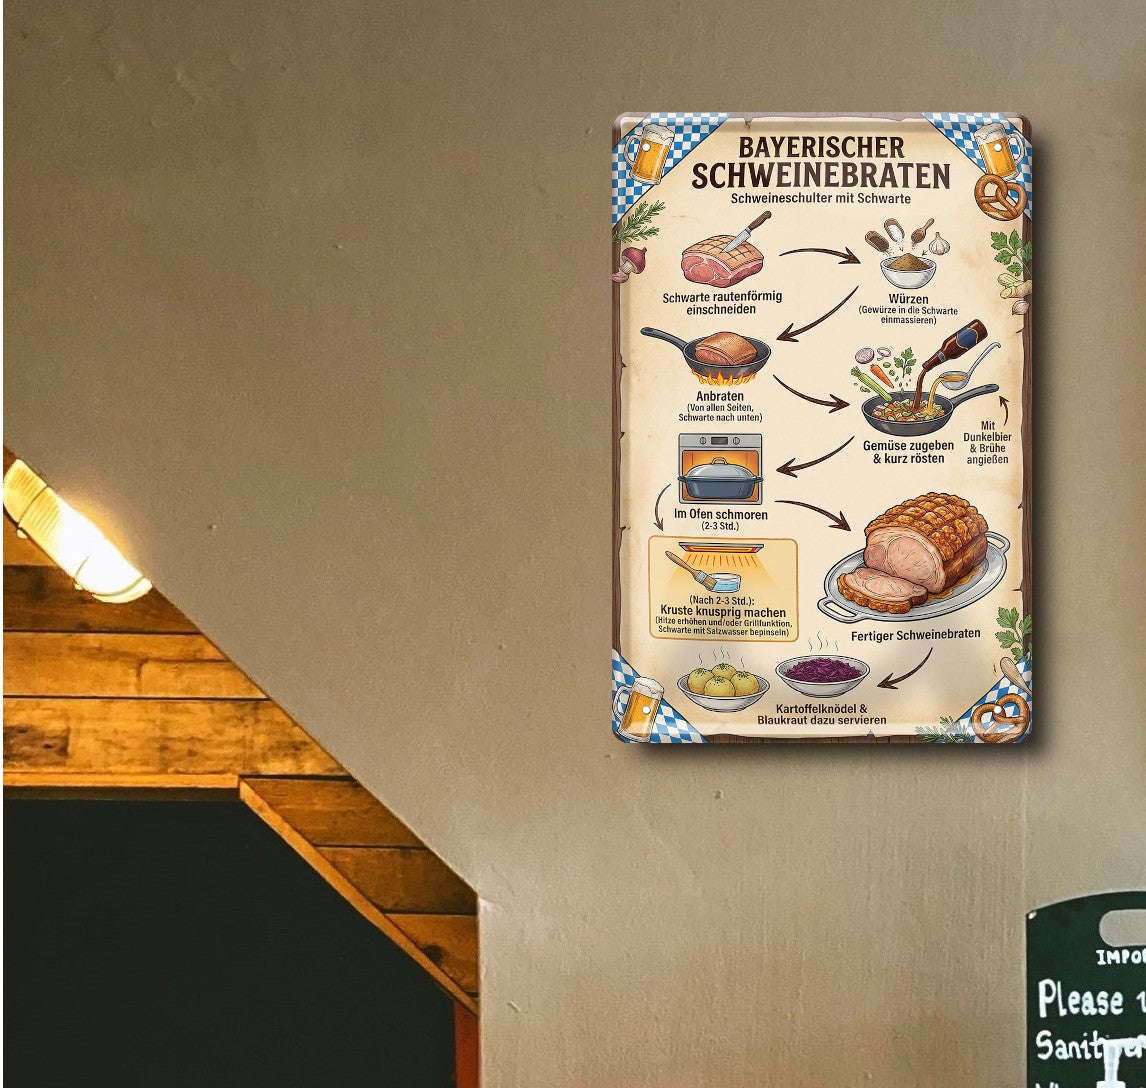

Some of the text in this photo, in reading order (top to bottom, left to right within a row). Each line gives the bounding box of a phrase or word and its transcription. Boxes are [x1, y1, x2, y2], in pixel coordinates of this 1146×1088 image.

[739, 136, 905, 158] BAYERISCHER
[691, 163, 951, 189] SCHWEINEBRATEN
[731, 192, 911, 204] Schweineschulter mit Schwarte
[663, 290, 782, 304] Schwarte rautenförmig
[889, 293, 929, 305] Würzen
[686, 303, 756, 316] einschneiden
[859, 305, 958, 316] (Gewürze in die Schwarte
[881, 315, 937, 326] einmassieren)
[696, 391, 744, 402] Anbraten
[687, 403, 754, 413] (Von allen Seiten,
[678, 413, 763, 422] Schwarte nach unten)
[981, 421, 995, 430] Mit
[964, 432, 1012, 442] Dunkelbier
[863, 439, 954, 453] Gemüse zugeben
[970, 443, 1006, 453] & Brühe
[873, 452, 945, 464] & kurz rösten
[967, 454, 1009, 465] angießen
[674, 508, 768, 521] Im Ofen schmoren
[701, 521, 740, 531] (2-3 Std.)
[689, 595, 755, 606] (Nach 2-3 Std.):
[660, 605, 786, 620] Kruste knusprig machen
[655, 616, 793, 628] (Hitze erhöhen und/oder Grillfunktion,
[658, 625, 790, 637] Schwarte mit Salzwasser bepinseln)
[851, 628, 981, 642] Fertiger Schweinebraten
[775, 703, 867, 715] Kartoffelknödel &
[757, 715, 887, 725] Blaukraut dazu servieren
[1038, 978, 1124, 1018] Please
